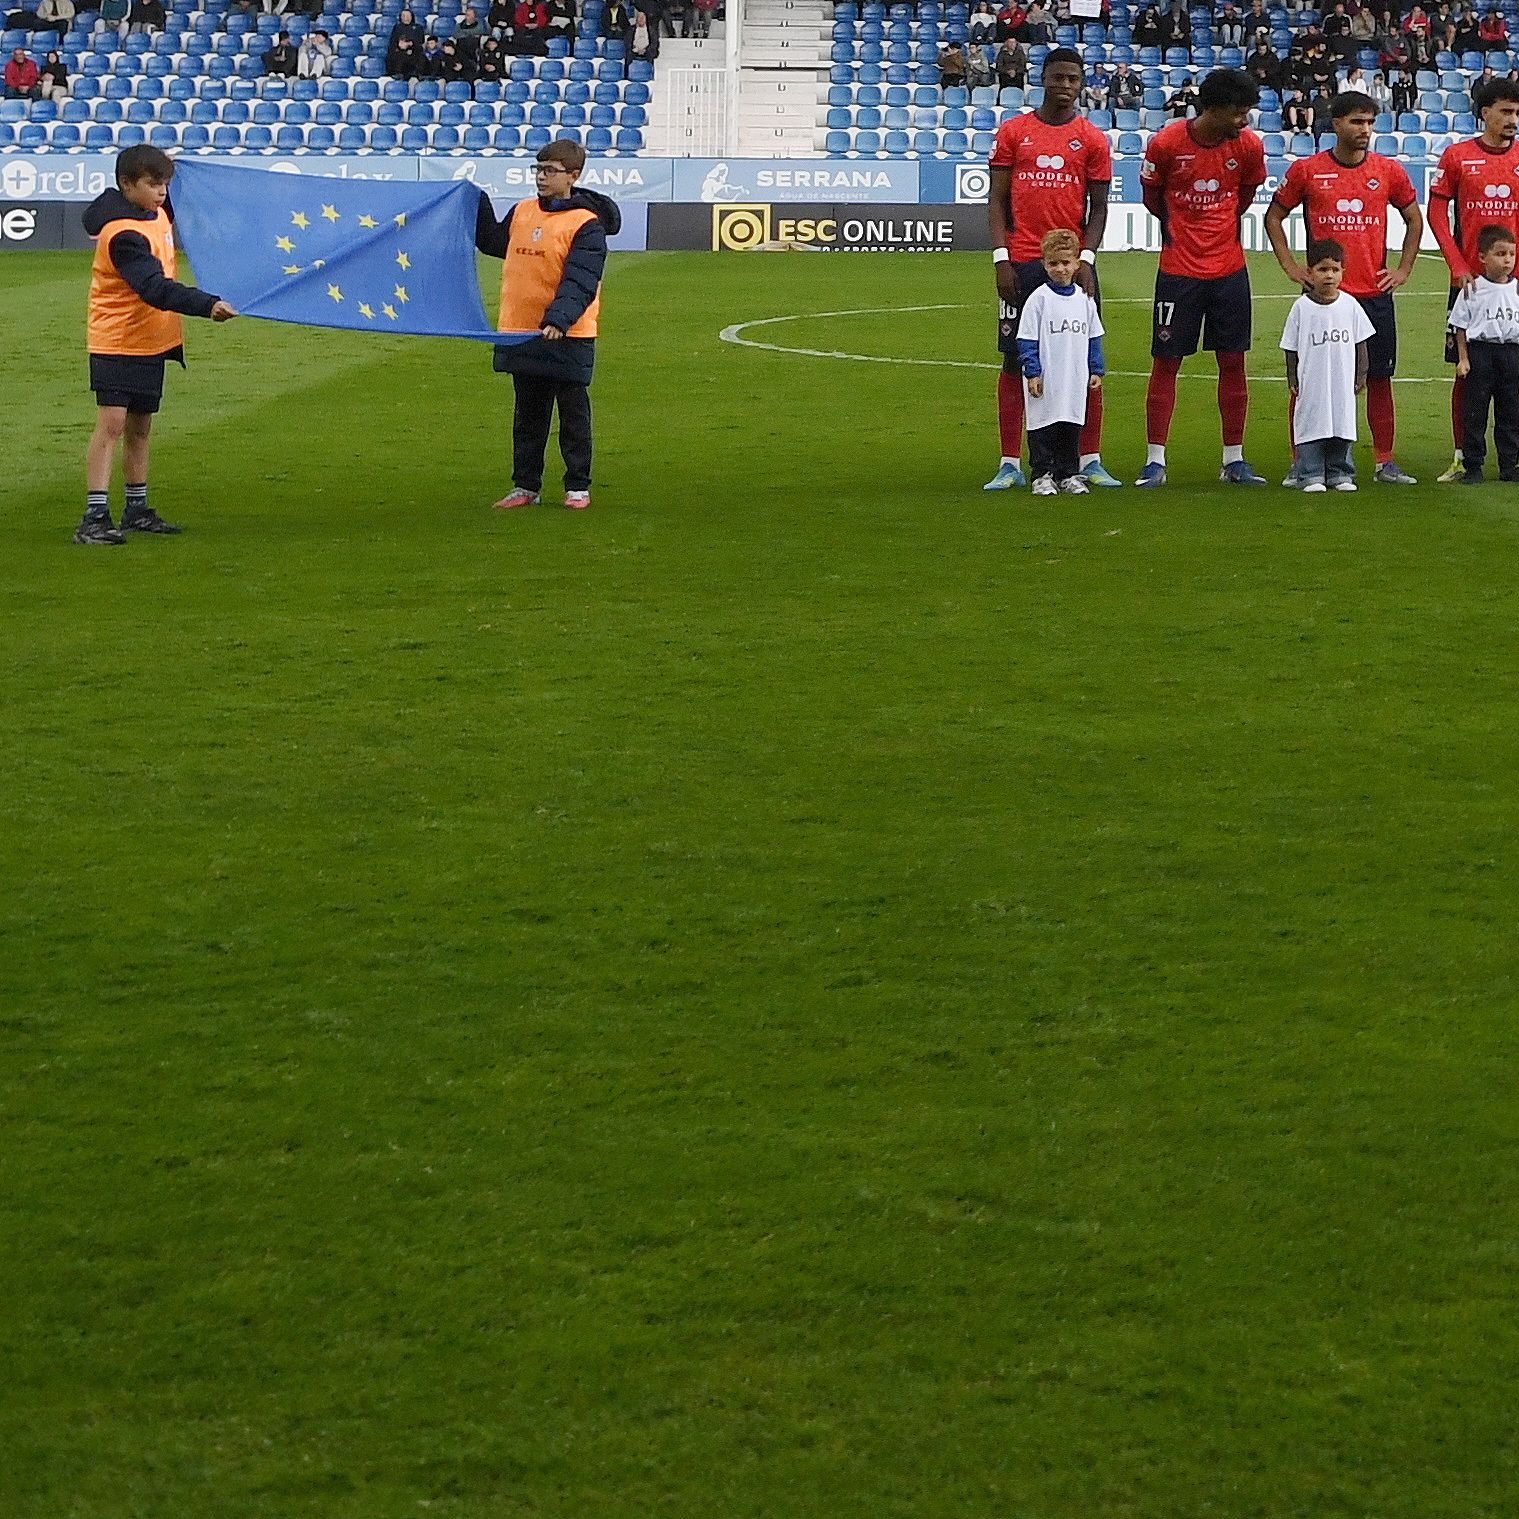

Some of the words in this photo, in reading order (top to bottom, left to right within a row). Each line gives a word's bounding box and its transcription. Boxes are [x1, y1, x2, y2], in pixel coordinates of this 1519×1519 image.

[38, 162, 118, 196] rela
[505, 167, 645, 186] SEANA
[756, 170, 892, 189] SERRANA
[1018, 170, 1080, 184] ONODERA
[1318, 215, 1380, 225] ONODERA
[1332, 224, 1367, 232] GROUP
[778, 218, 838, 242] ESC
[843, 220, 954, 243] ONLINE
[1157, 301, 1175, 326] 17
[1311, 328, 1350, 347] LAGO
